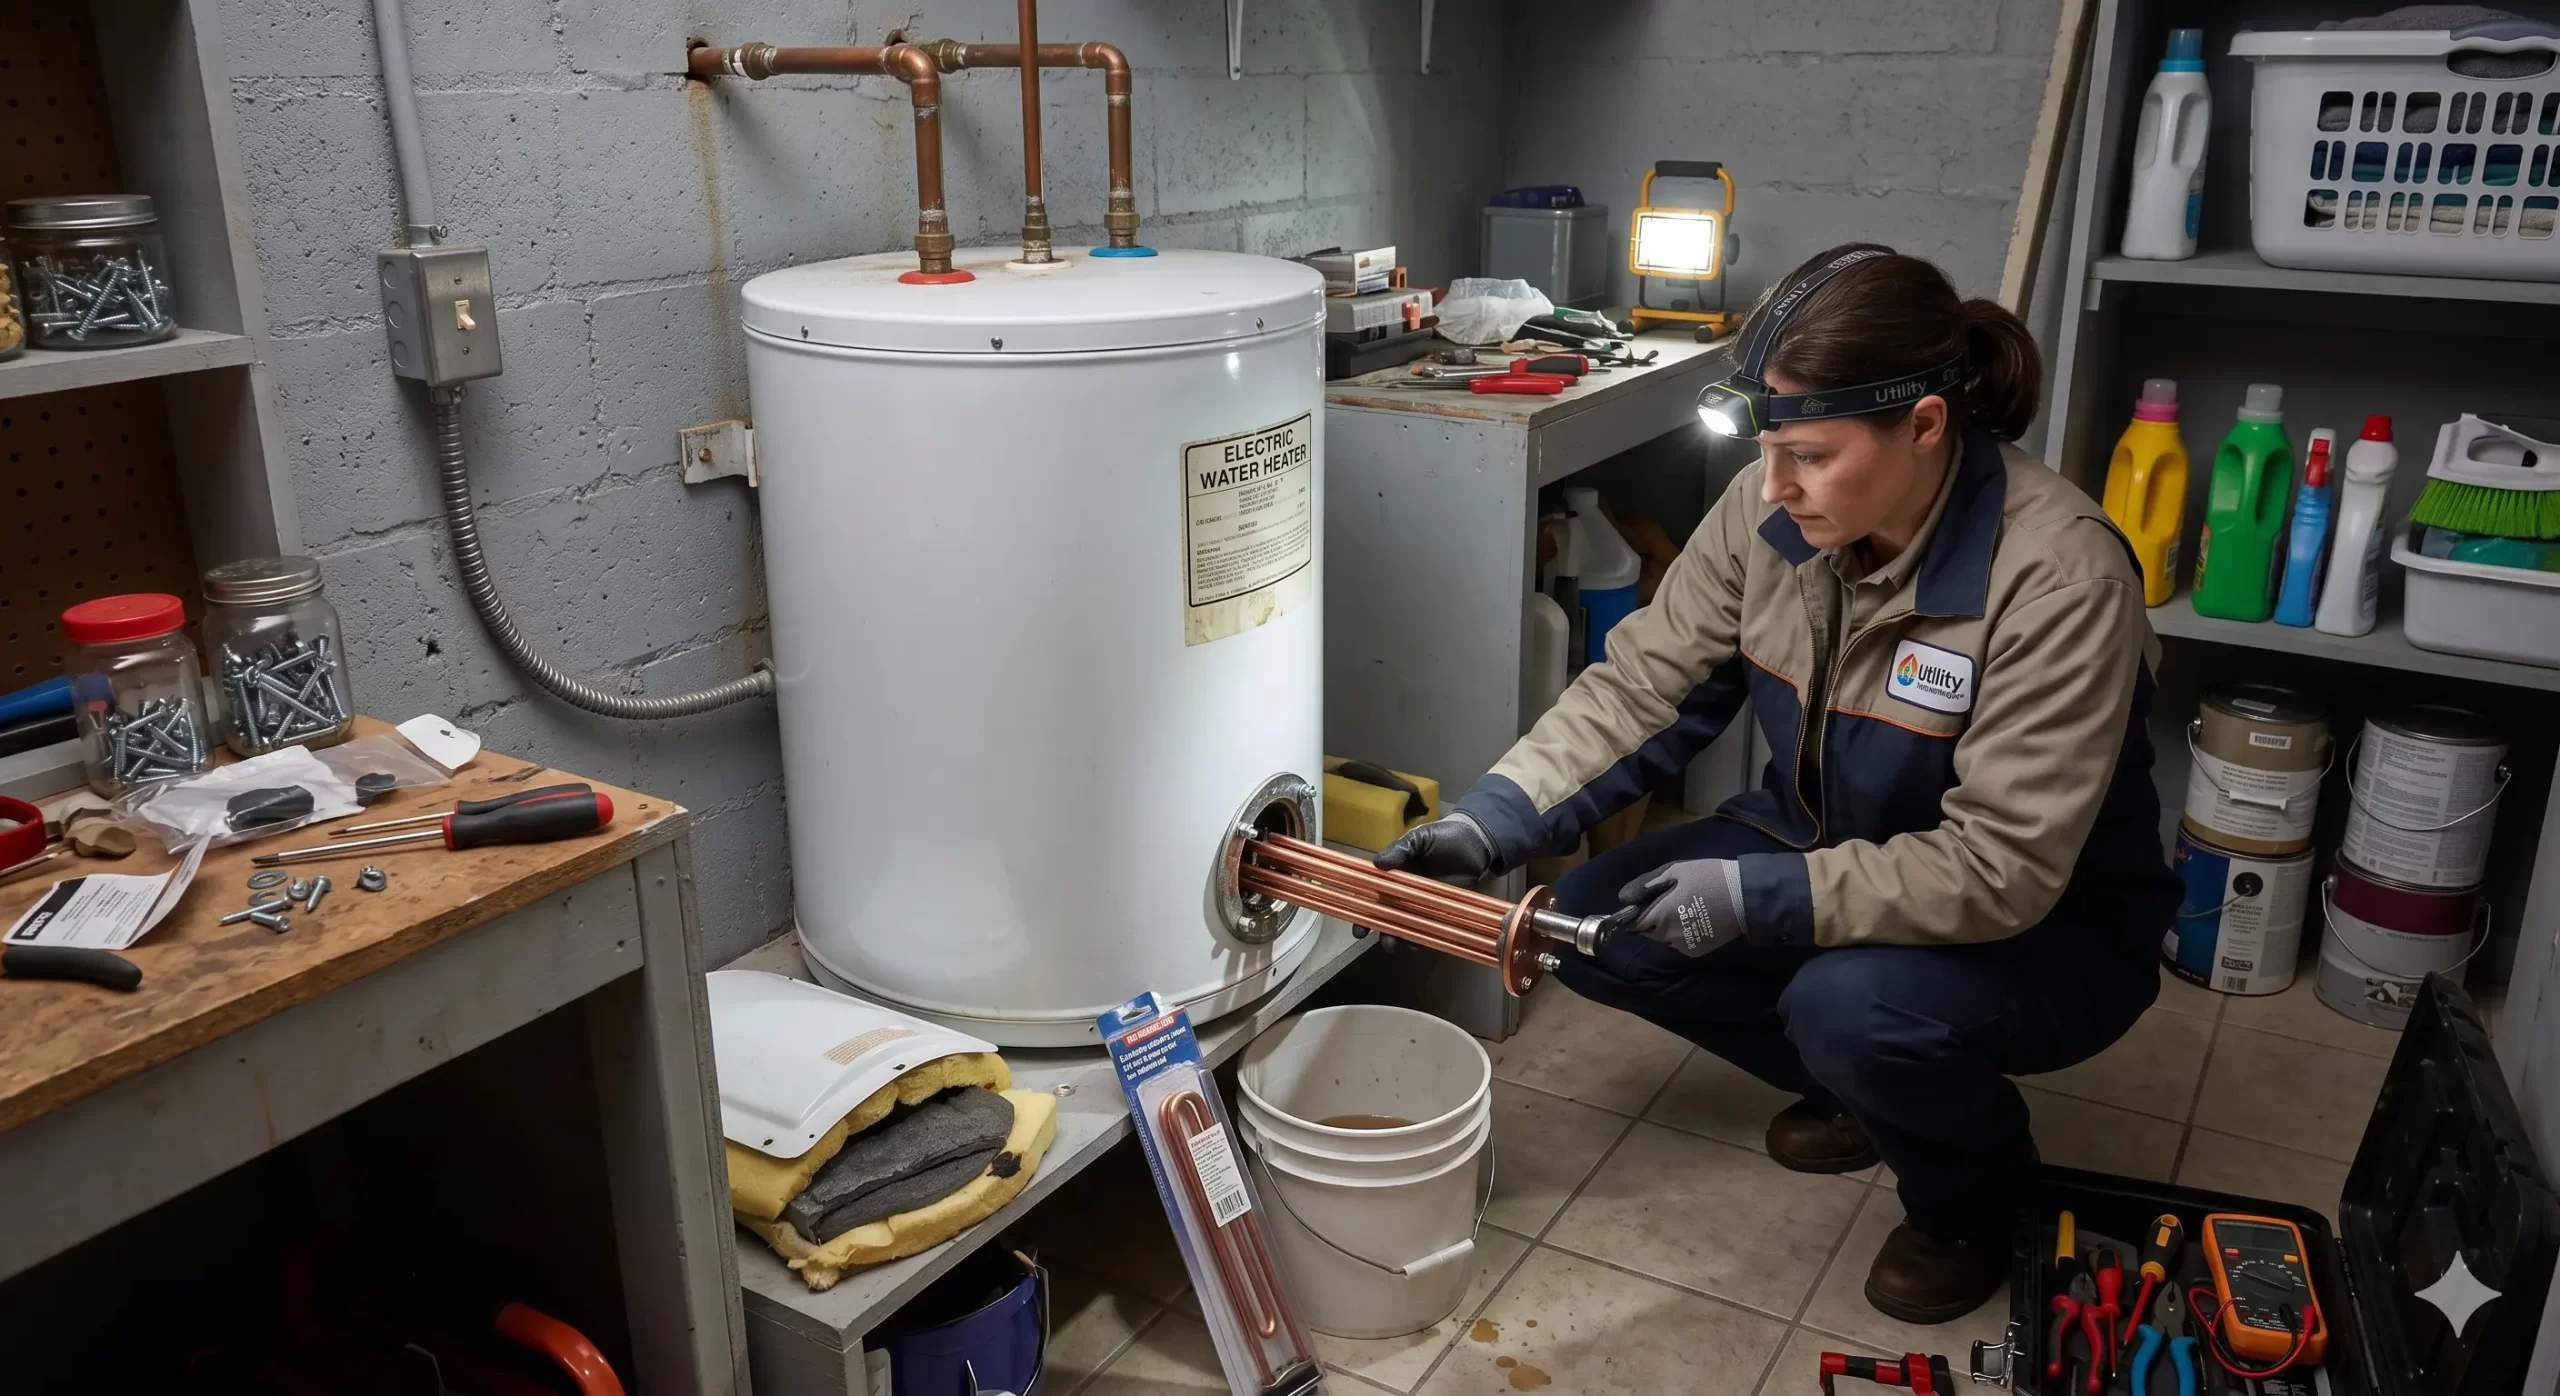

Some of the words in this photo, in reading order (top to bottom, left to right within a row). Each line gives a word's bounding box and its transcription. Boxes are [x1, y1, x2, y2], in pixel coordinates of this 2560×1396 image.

[1875, 379, 1928, 404] Utility
[1225, 428, 1294, 464] ELECTRIC
[1200, 461, 1259, 490] WATER
[1264, 443, 1307, 476] HEATER
